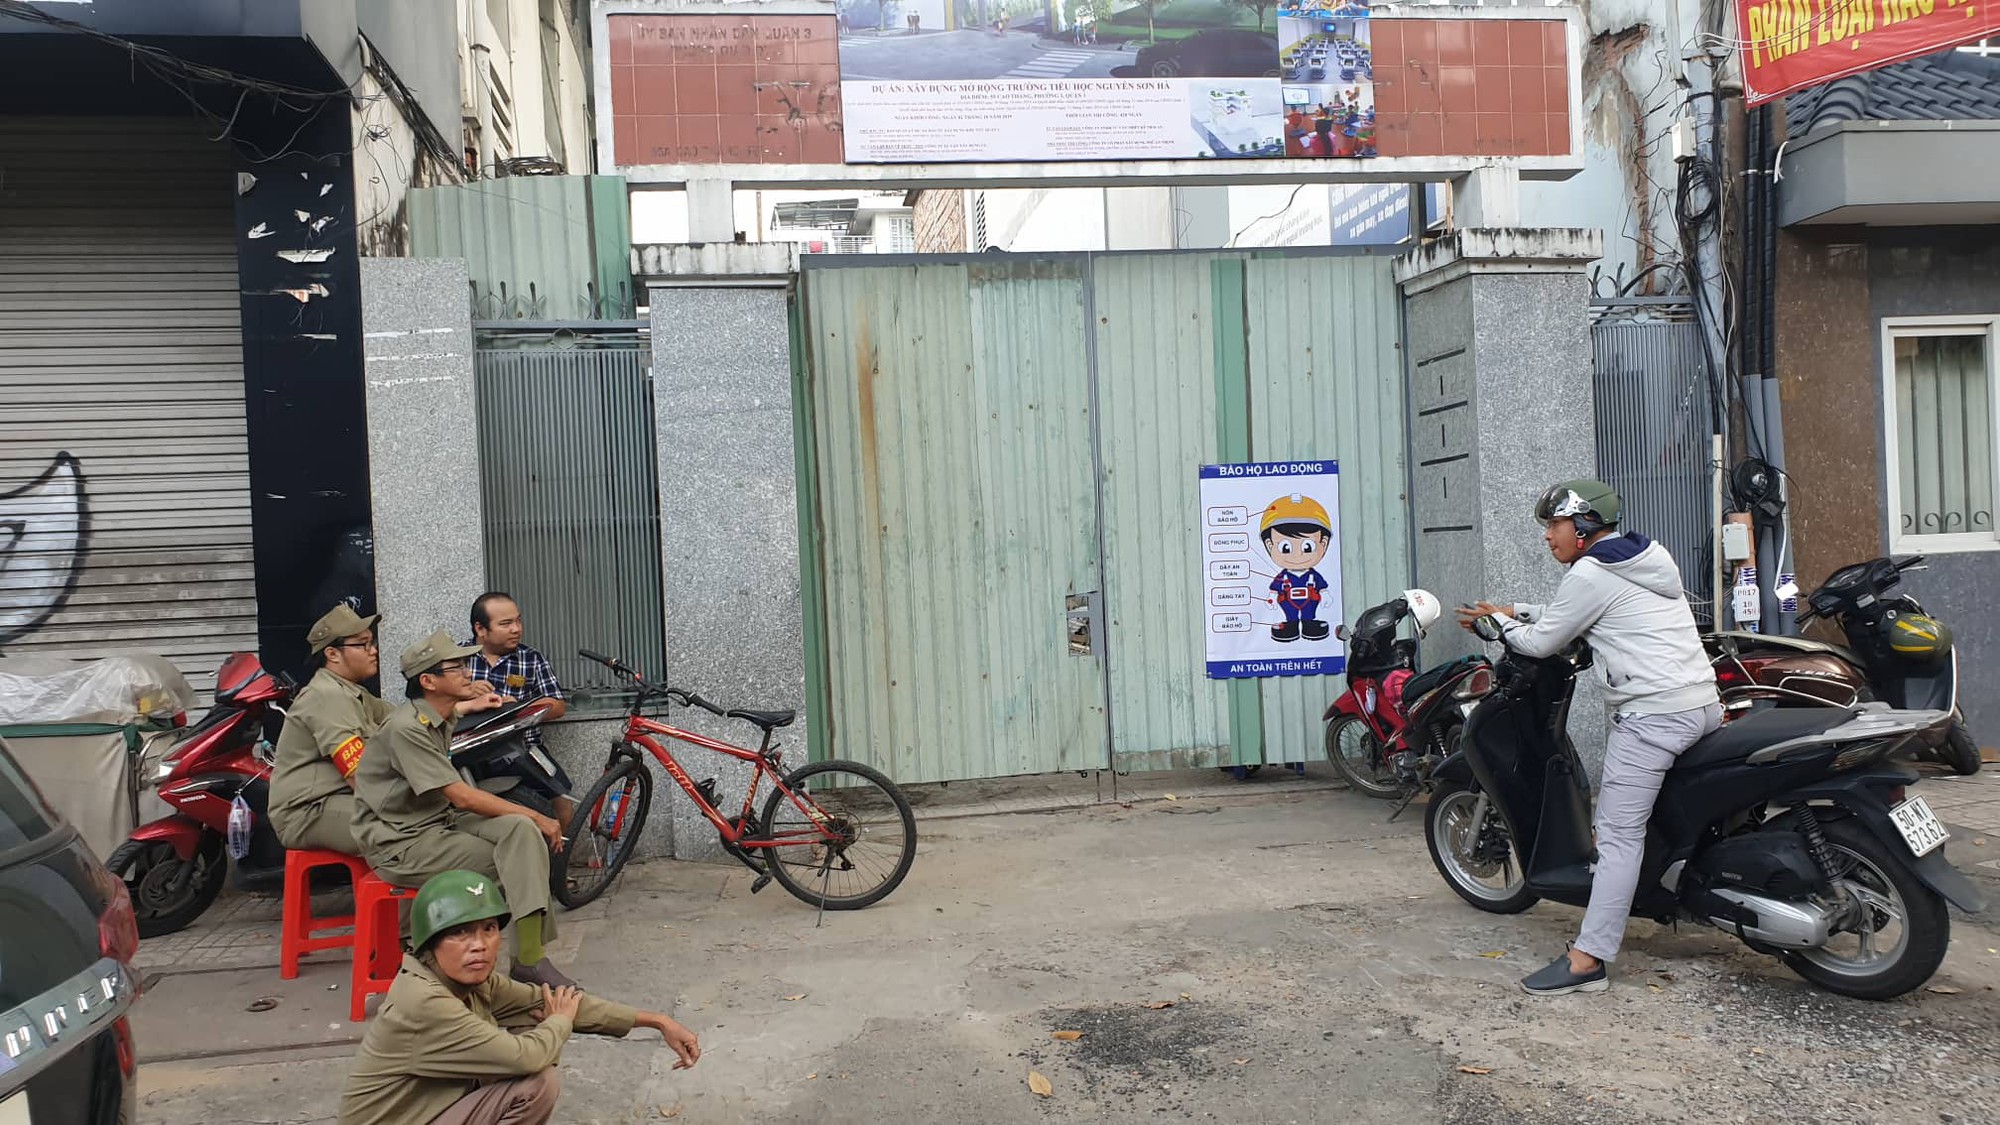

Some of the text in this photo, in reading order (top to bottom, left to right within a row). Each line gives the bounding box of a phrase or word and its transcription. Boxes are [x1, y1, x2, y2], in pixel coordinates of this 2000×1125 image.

[1220, 463, 1323, 476] BẢO HỘ LAO ĐỘNG
[1230, 658, 1322, 673] AN TOÀN TRÊN HẾT
